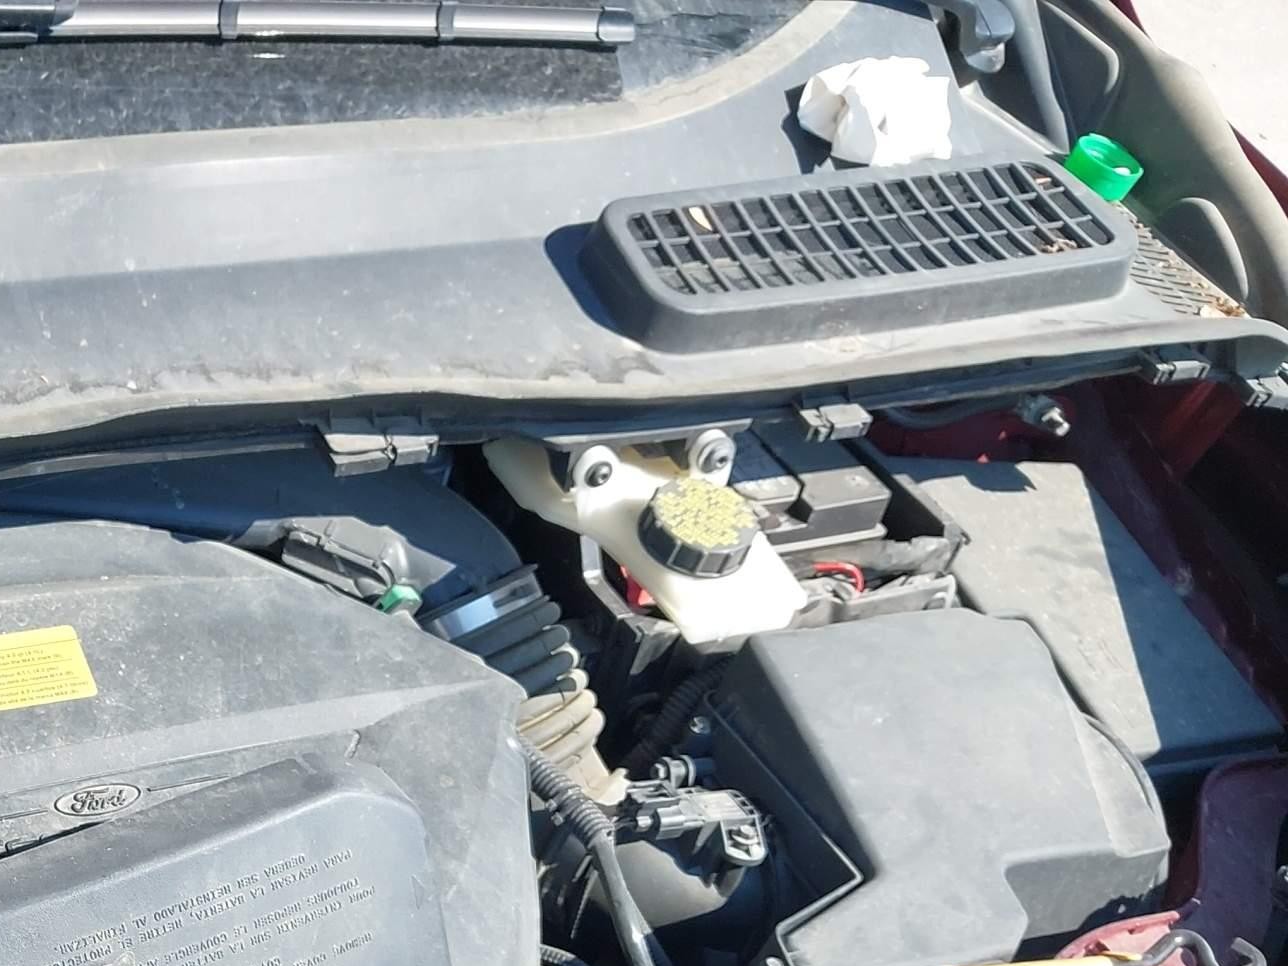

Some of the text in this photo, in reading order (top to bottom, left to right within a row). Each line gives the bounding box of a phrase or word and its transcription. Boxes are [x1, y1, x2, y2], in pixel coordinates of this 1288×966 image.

[323, 849, 352, 869] PARA
[270, 864, 319, 891] REVISAR
[249, 887, 265, 901] LA
[307, 877, 359, 906] TOUJOURS
[153, 884, 232, 922] REINSTALADO
[132, 916, 147, 929] AL
[139, 919, 183, 942] RETIRE
[54, 923, 127, 955] FINALIZAR.
[118, 938, 133, 949] EL
[164, 931, 228, 964] COUVERCLE
[228, 941, 245, 955] LA
[249, 930, 272, 946] SUR
